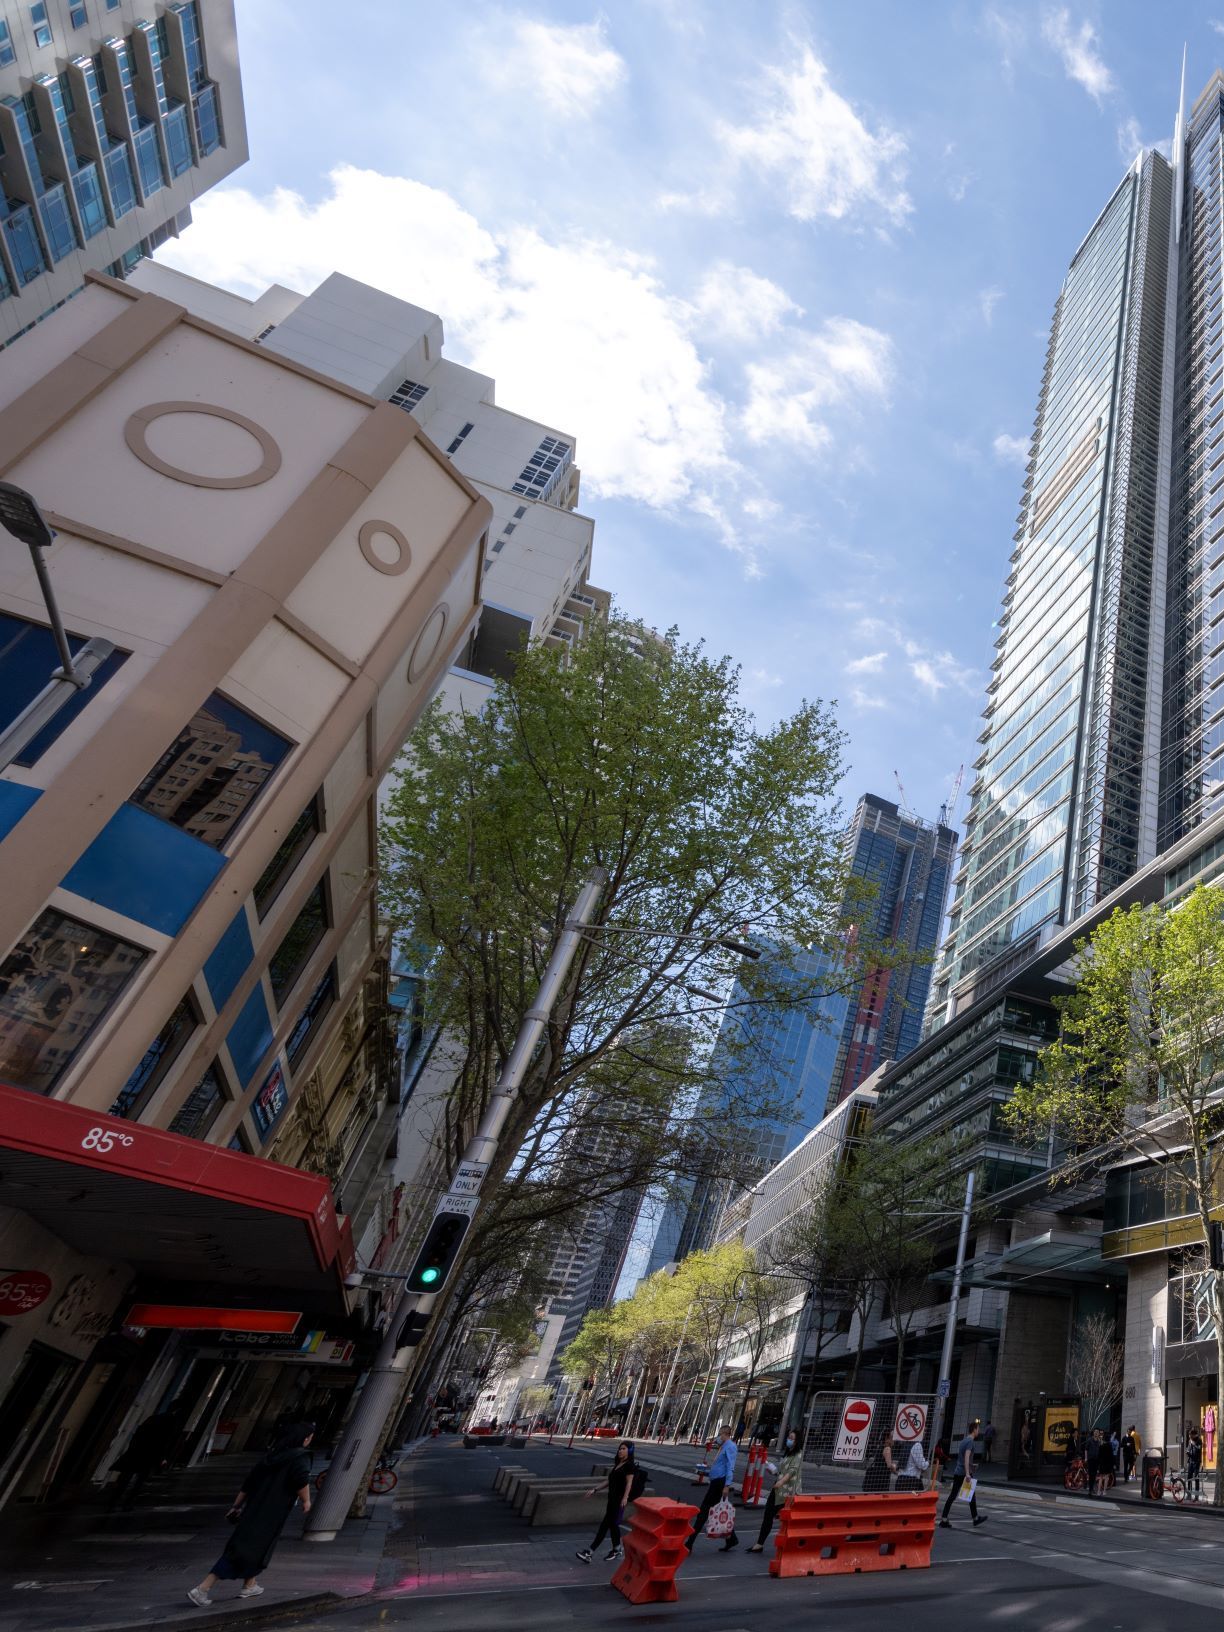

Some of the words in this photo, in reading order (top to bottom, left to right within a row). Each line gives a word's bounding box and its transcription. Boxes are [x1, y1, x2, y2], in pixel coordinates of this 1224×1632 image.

[81, 1127, 134, 1153] 85°C
[455, 1180, 478, 1190] ONLY
[445, 1198, 472, 1207] RIGHT
[844, 1435, 860, 1445] NO
[836, 1447, 863, 1457] ENTRY
